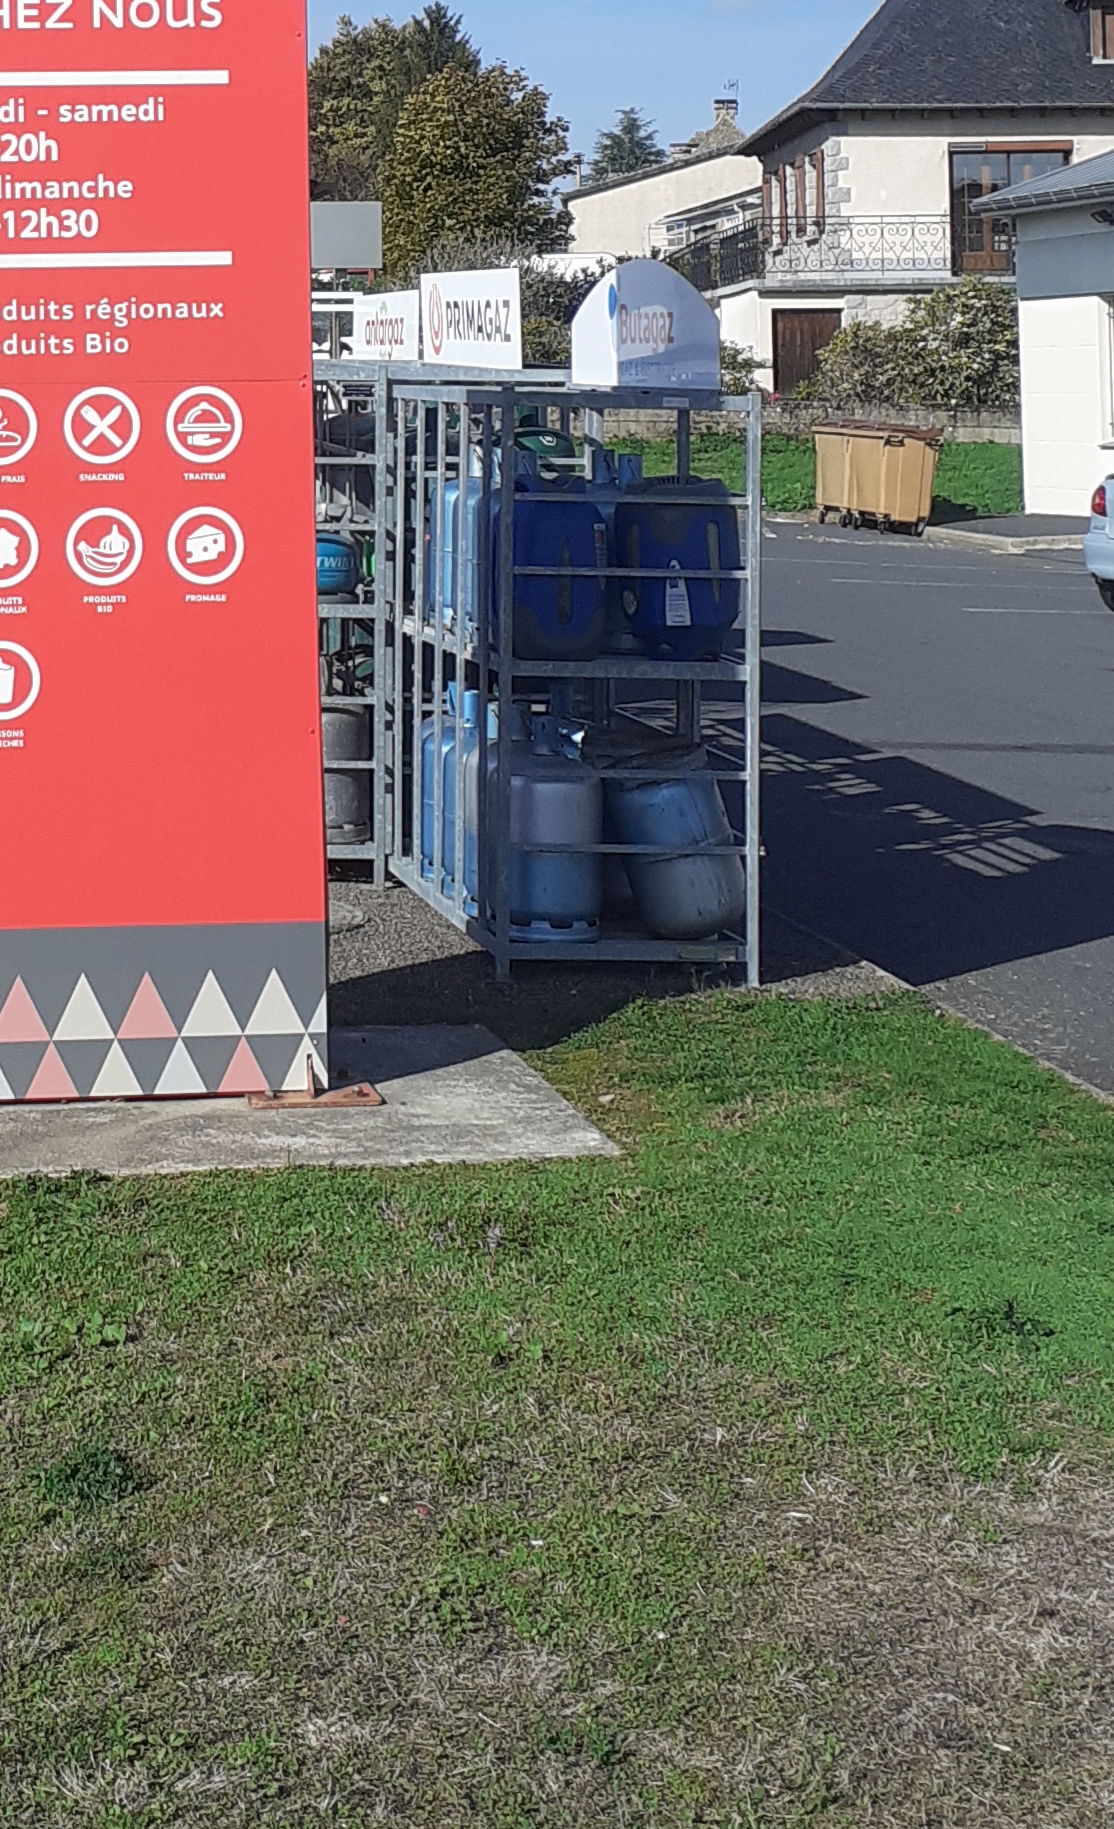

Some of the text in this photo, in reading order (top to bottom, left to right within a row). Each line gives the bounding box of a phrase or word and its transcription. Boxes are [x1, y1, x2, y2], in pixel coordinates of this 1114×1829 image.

[58, 95, 165, 123] samedi
[85, 296, 225, 328] régionaux
[445, 299, 511, 342] PRIMAGAZ
[364, 310, 405, 360] antargaz
[618, 303, 675, 353] Butagaz
[84, 330, 131, 356] Bio
[79, 473, 126, 482] SNACKING
[183, 472, 227, 481] TRAITEUR
[83, 595, 127, 604] PRODUITS
[97, 604, 114, 613] BIO
[185, 593, 228, 603] FROMAGE
